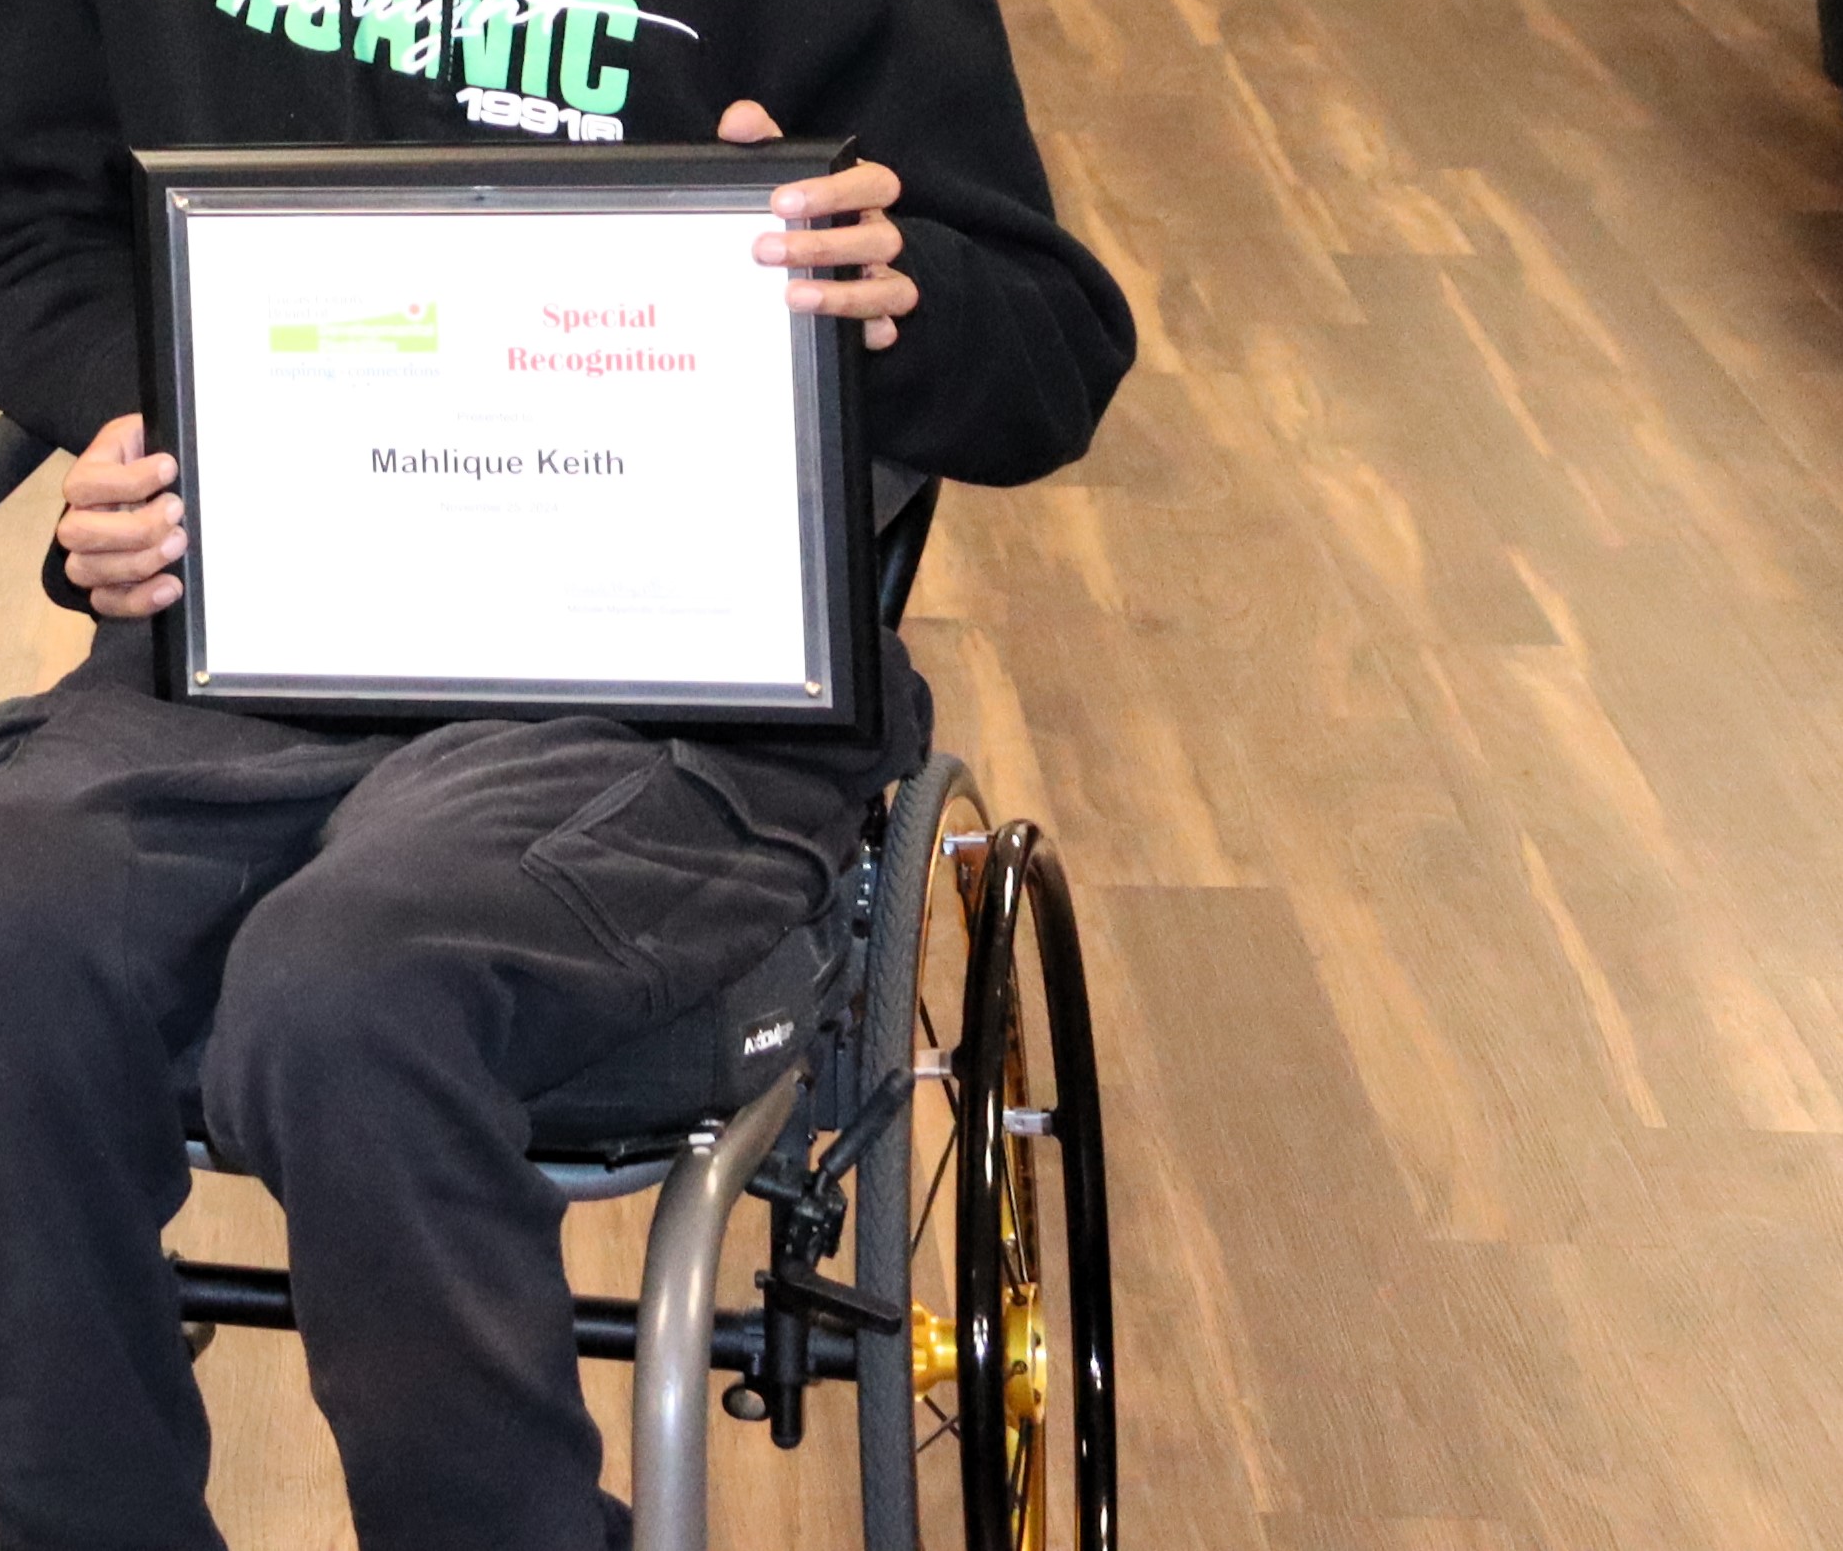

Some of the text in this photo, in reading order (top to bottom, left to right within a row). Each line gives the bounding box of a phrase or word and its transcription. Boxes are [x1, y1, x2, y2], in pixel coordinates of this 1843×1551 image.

[542, 303, 657, 334] Special
[268, 361, 441, 381] inspiring connections
[506, 346, 697, 378] Recognition
[371, 448, 625, 481] Mahlique Keith
